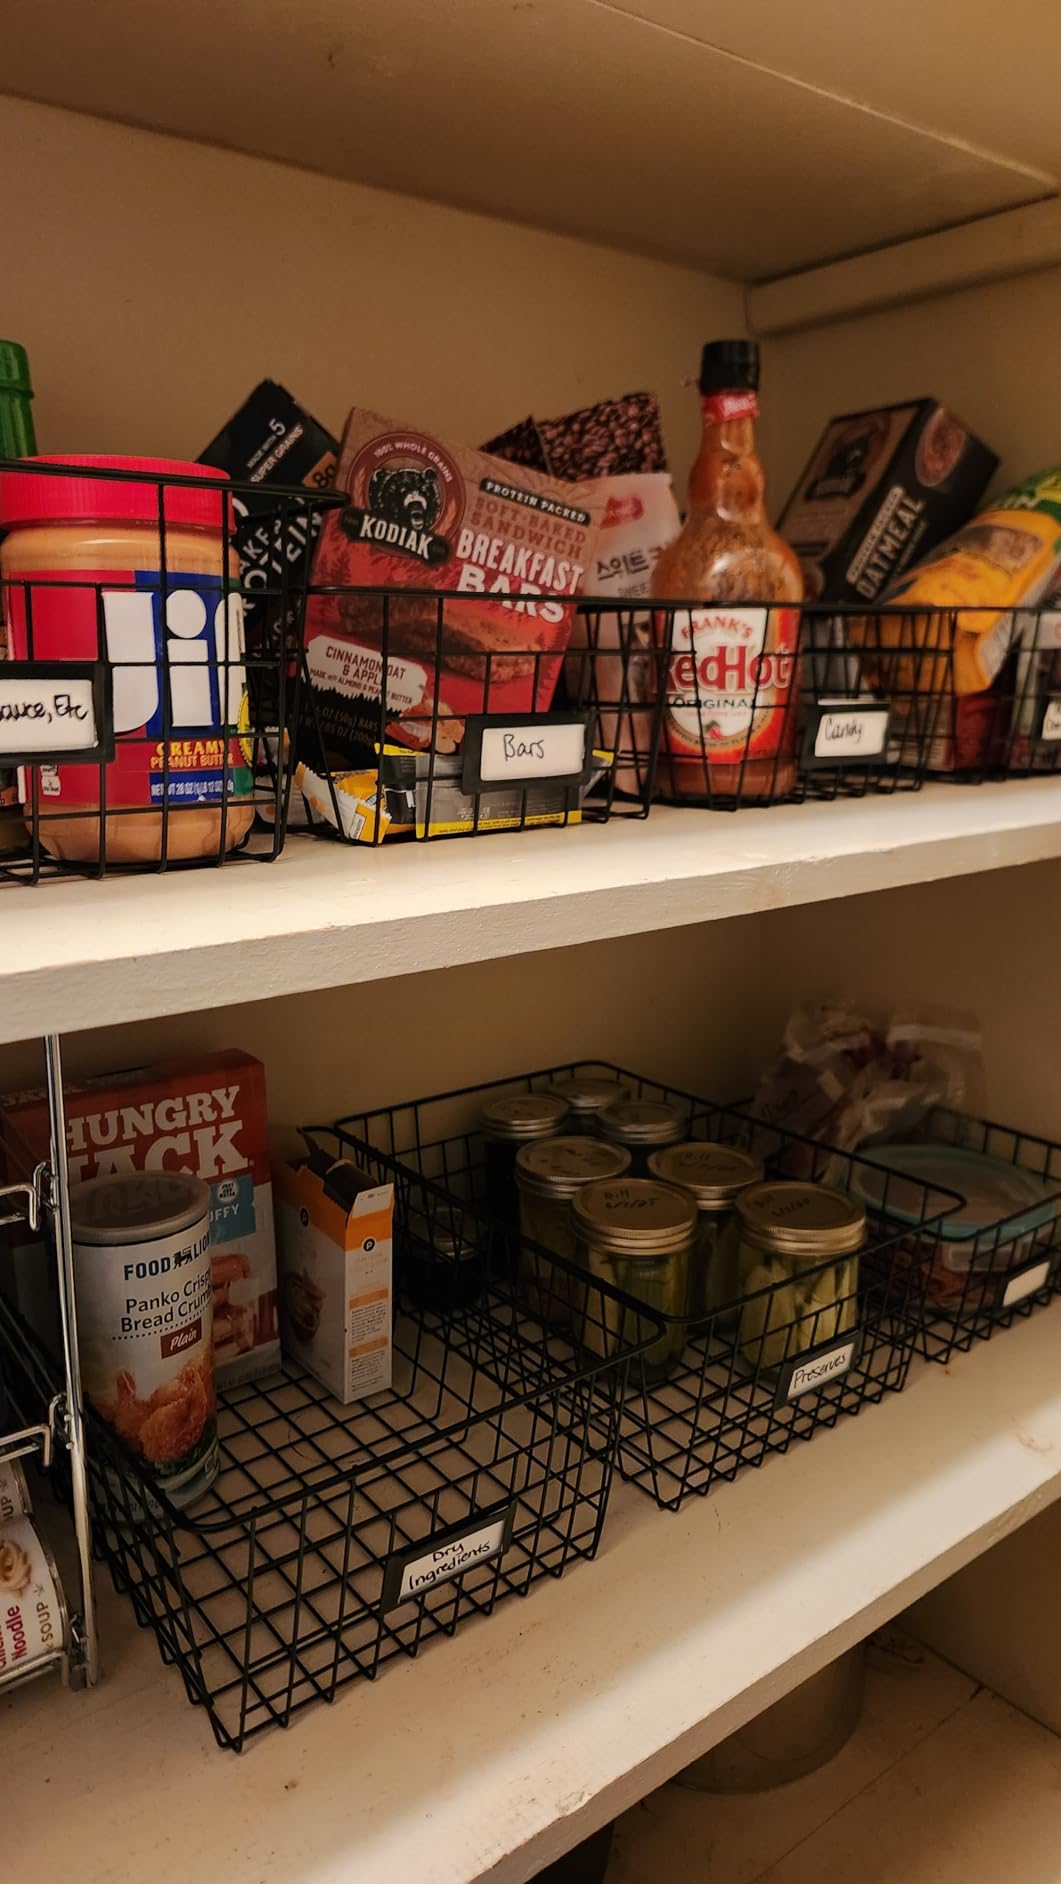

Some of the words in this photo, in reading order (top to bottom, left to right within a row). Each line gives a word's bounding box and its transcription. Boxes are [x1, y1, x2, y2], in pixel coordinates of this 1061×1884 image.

[269, 418, 286, 436] 5
[251, 456, 278, 482] SUPER
[275, 423, 304, 458] GRAINS
[374, 444, 394, 458] 100%
[395, 441, 427, 455] WHOLE
[427, 451, 453, 483] GRAINS
[475, 496, 587, 545] SOFT-BAKED
[486, 481, 538, 506] PROTEIN
[540, 500, 587, 523] PACKED
[359, 514, 434, 560] KODIAK
[470, 511, 583, 559] SANDWICH
[855, 497, 928, 600] OATMEAL
[456, 528, 585, 596] BREAKFAST
[456, 562, 566, 624] BARS
[681, 616, 753, 640] FRANK'S
[101, 588, 248, 735] Jif
[325, 645, 382, 674] CINNAMON
[342, 664, 350, 677] &
[339, 676, 361, 690] ALMOND
[503, 734, 546, 762] Bars
[825, 714, 864, 745] Candy
[65, 1085, 241, 1151] HUNGRY
[123, 1256, 171, 1281] FOOD
[120, 1309, 174, 1334] Bread
[125, 1289, 181, 1315] Panko
[169, 1326, 198, 1351] Plain
[794, 1351, 847, 1389] Preserves
[408, 1540, 491, 1590] Ingredients
[432, 1543, 465, 1562] Dry
[5, 1604, 28, 1662] Noodle
[35, 1601, 54, 1643] SOUP
